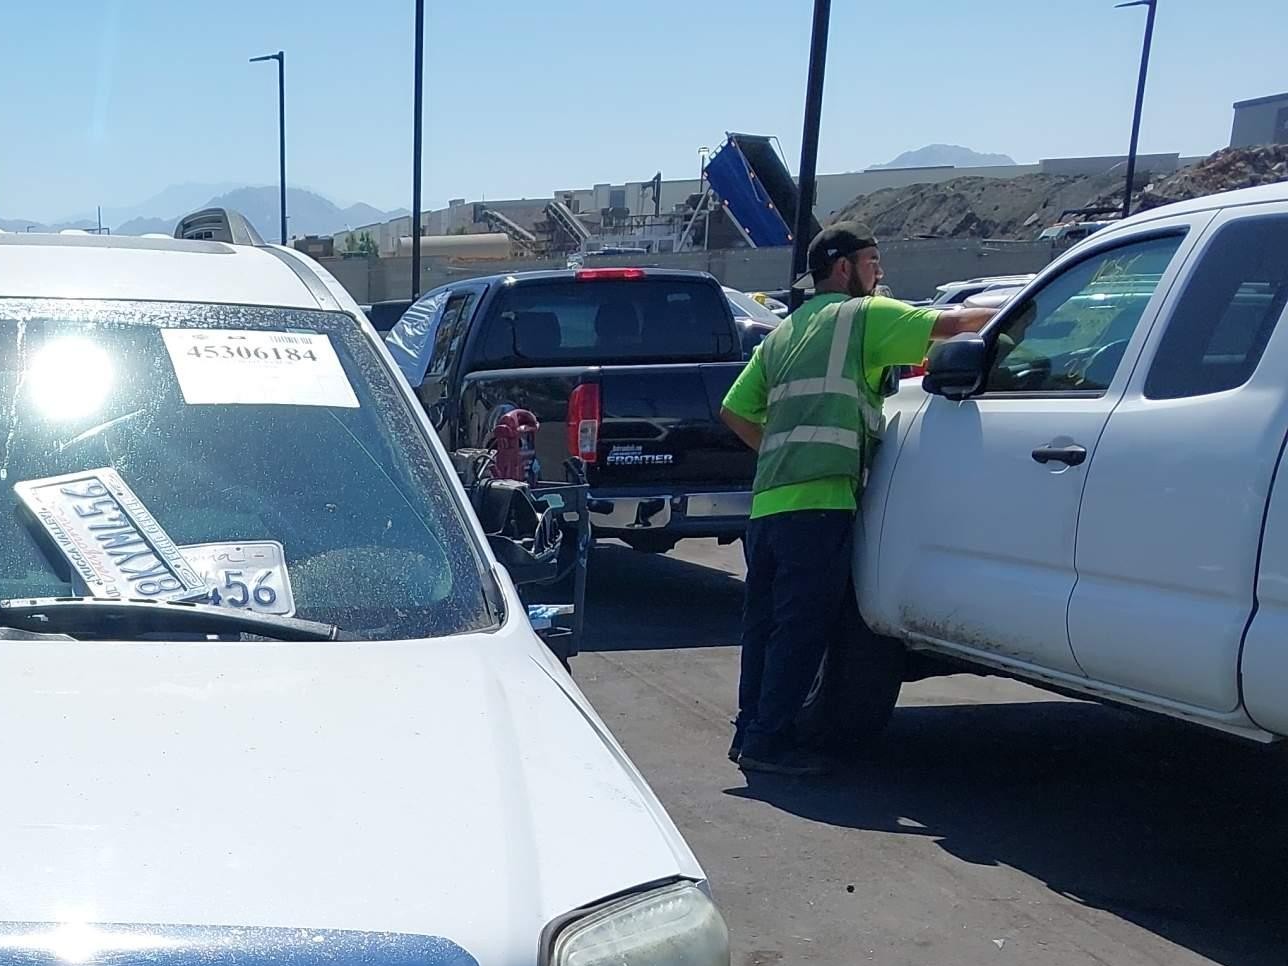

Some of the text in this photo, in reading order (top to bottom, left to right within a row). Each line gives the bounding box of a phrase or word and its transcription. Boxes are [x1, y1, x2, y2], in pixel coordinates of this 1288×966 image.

[186, 345, 318, 362] 45306184
[606, 454, 673, 466] FRONTIER
[65, 546, 98, 583] YUCCA
